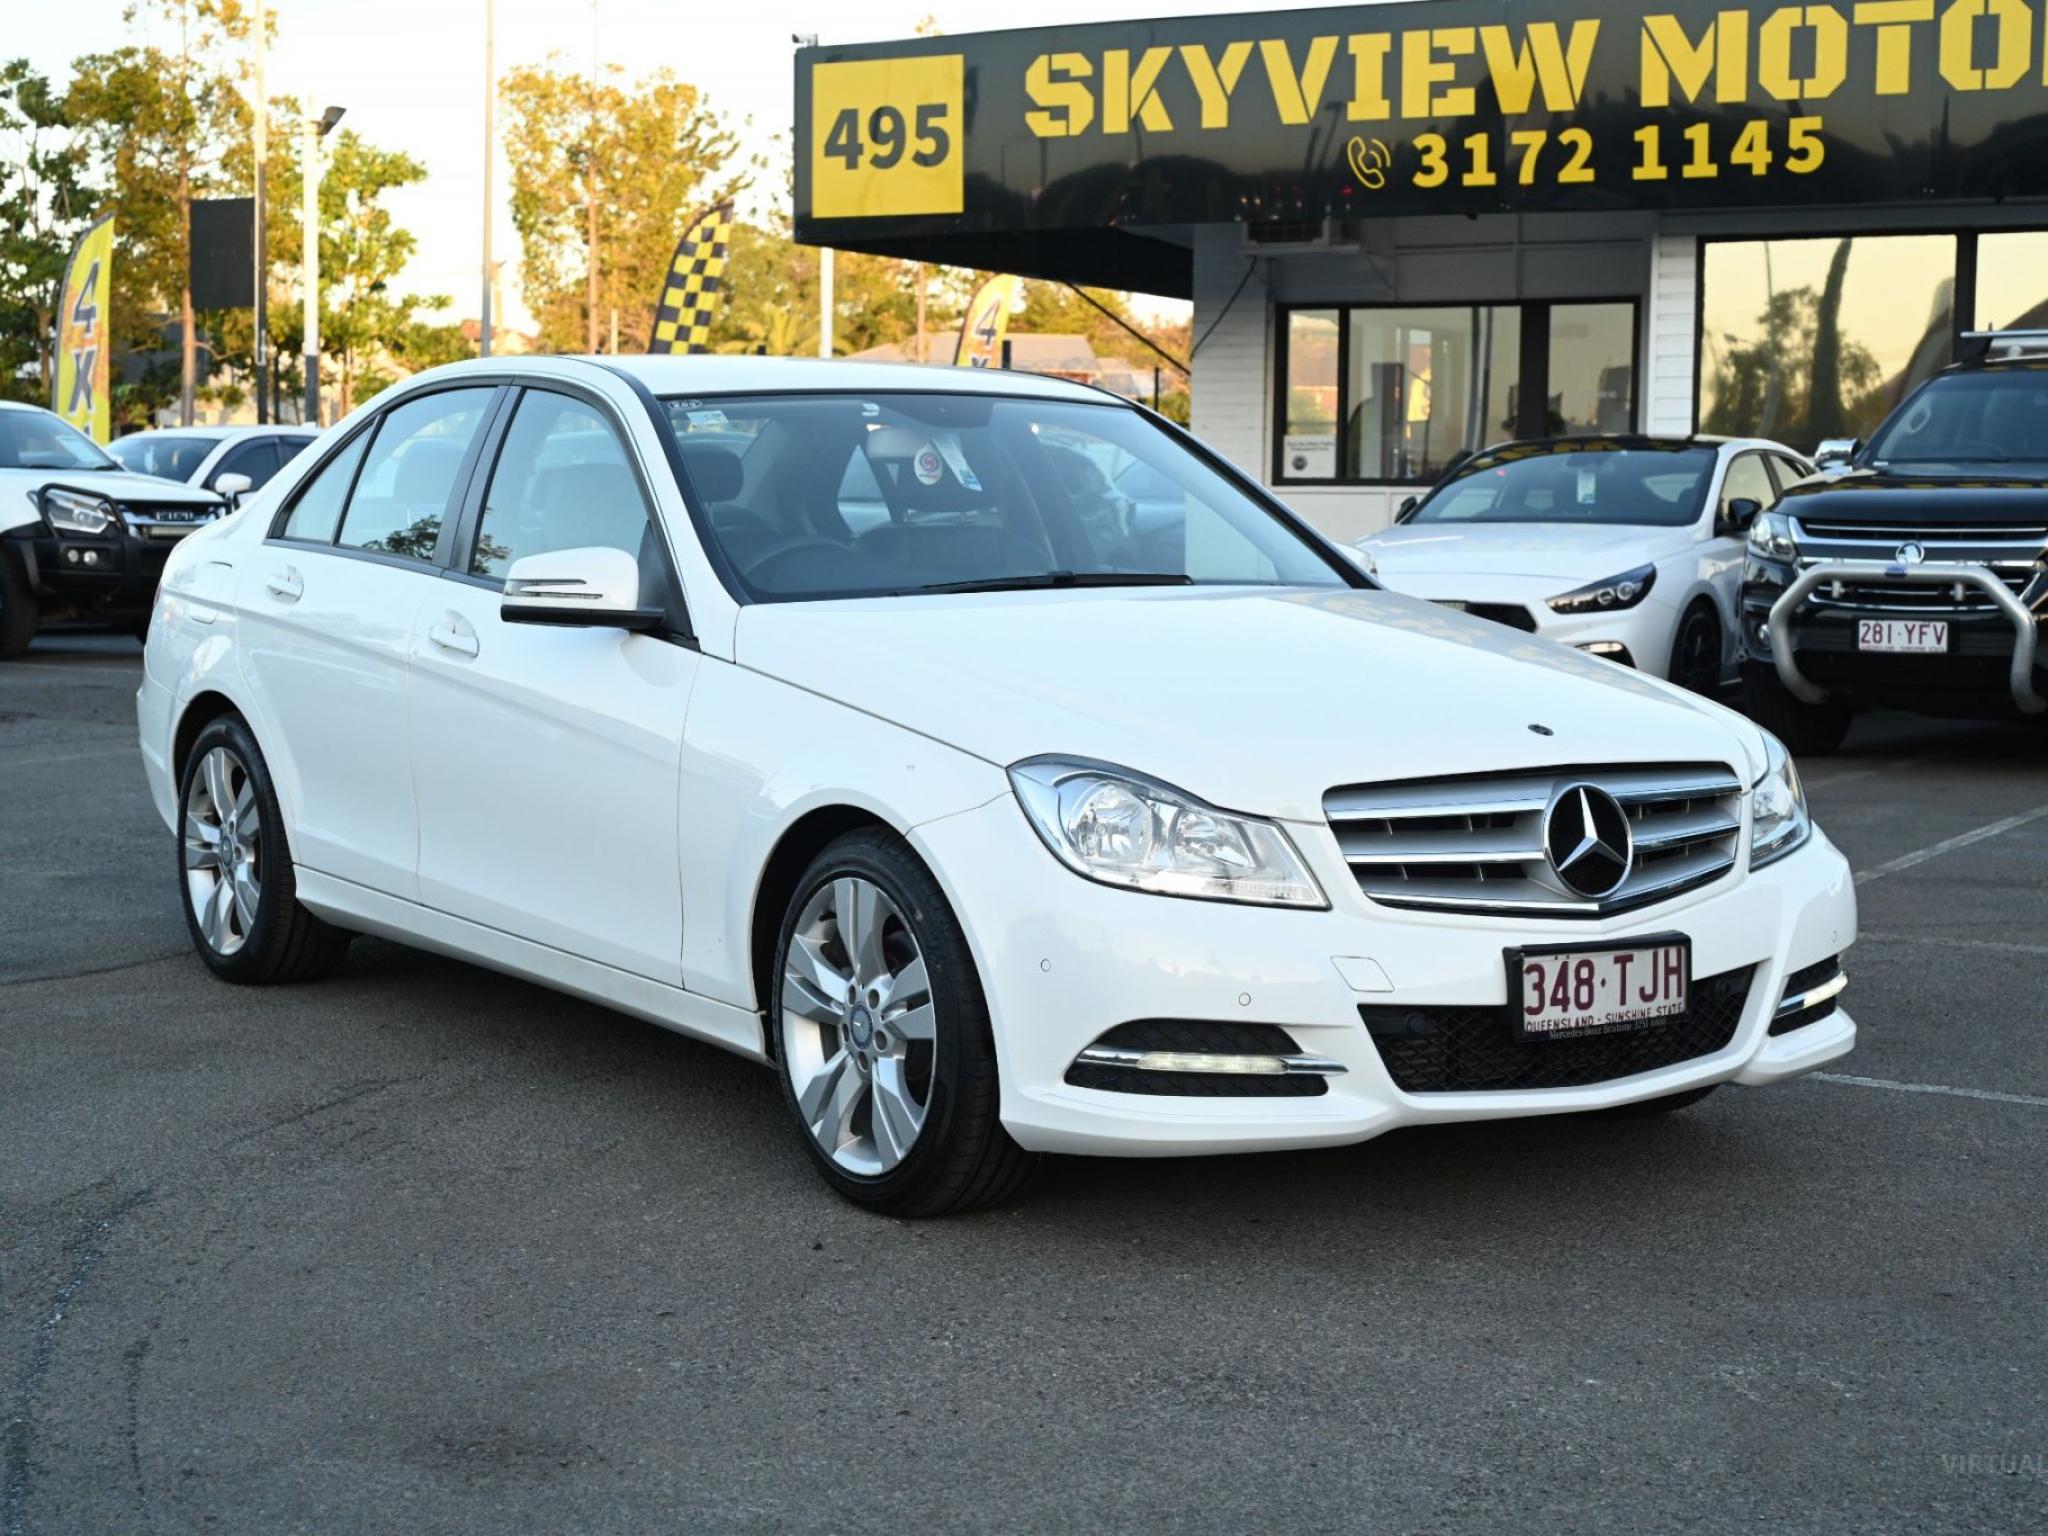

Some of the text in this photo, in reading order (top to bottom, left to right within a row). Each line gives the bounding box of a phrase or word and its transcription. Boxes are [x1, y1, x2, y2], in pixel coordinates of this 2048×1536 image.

[1024, 0, 2048, 138] SKYVIEW MOTO
[824, 103, 949, 170] 495
[1412, 115, 1825, 188] 3172 1145
[1526, 1014, 1595, 1033] QUEENSLAND
[1605, 1008, 1652, 1025] SUNSHINE
[1656, 1002, 1684, 1019] STATE
